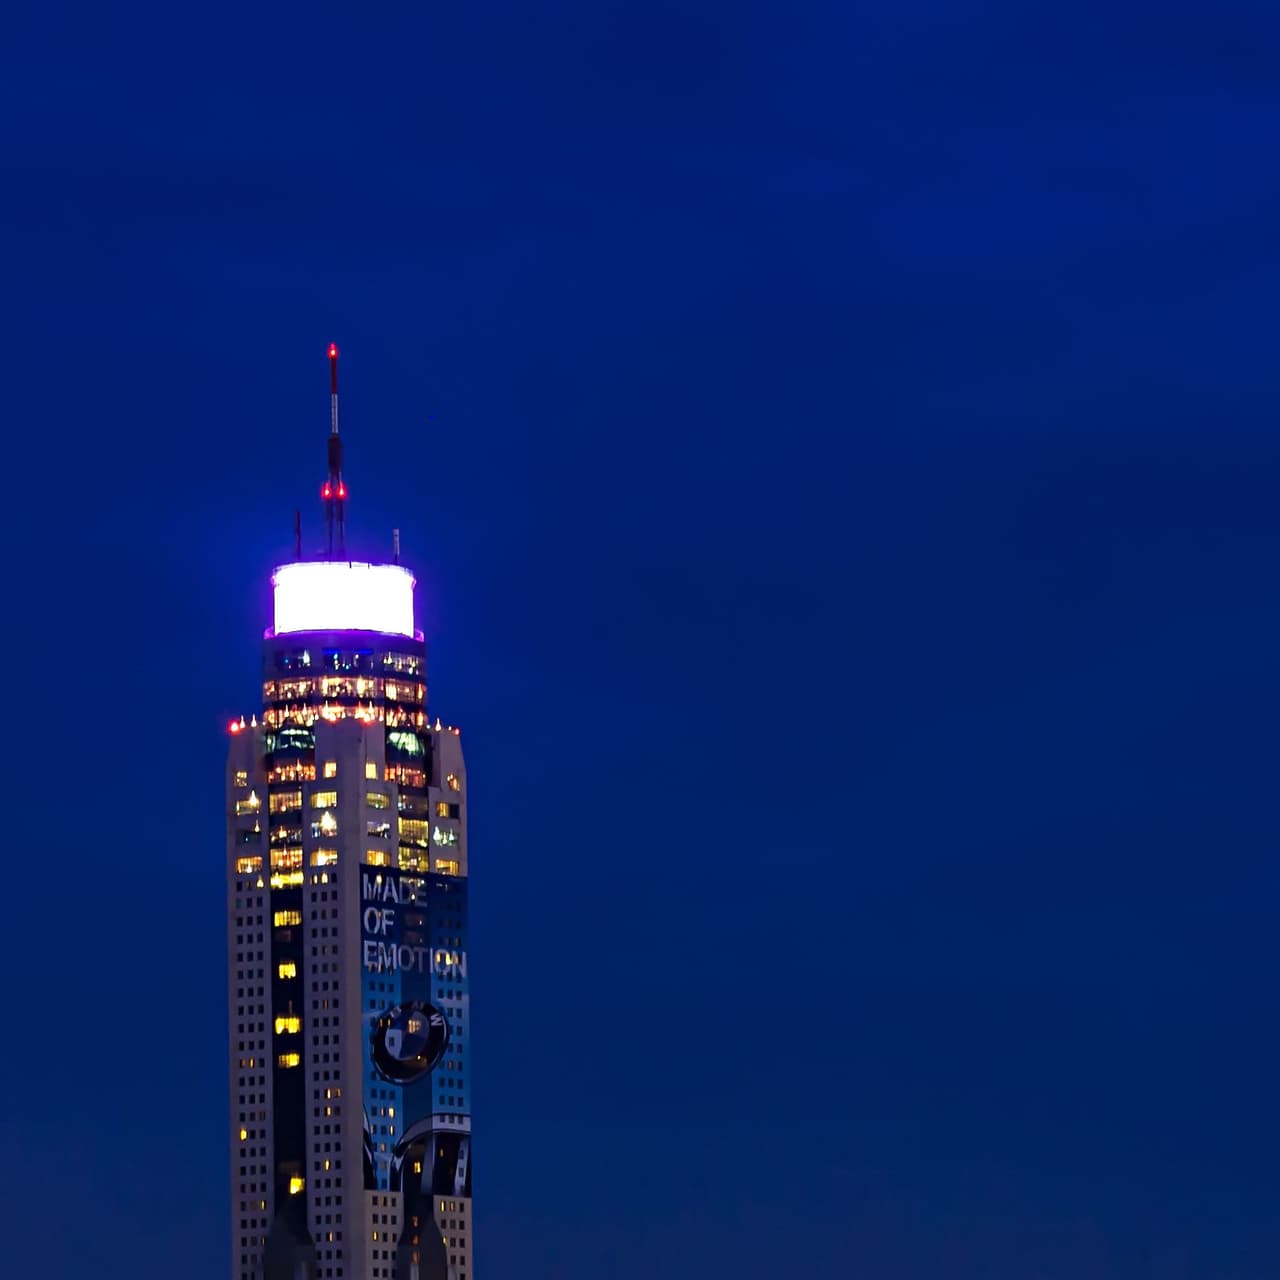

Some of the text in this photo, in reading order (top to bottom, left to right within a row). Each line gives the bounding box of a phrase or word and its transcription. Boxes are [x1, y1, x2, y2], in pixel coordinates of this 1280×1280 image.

[362, 873, 428, 907] MADE
[363, 907, 395, 936] OF
[363, 940, 467, 977] EMOTION
